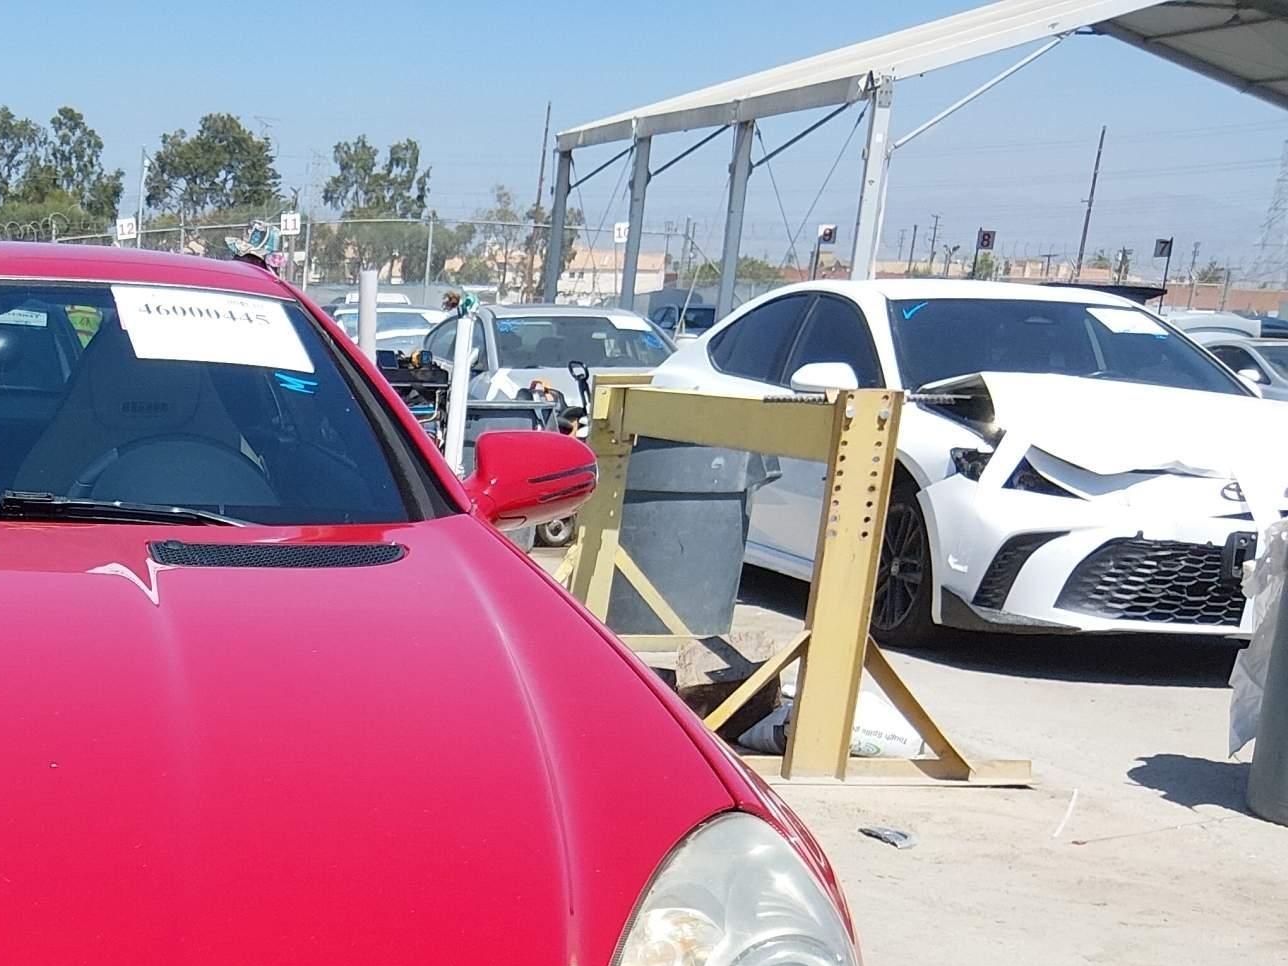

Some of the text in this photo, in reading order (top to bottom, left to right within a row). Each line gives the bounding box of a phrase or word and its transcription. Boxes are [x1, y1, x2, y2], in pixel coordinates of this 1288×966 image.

[119, 222, 135, 235] 12
[282, 218, 299, 231] 11
[824, 228, 833, 241] 9
[981, 234, 991, 246] 8
[1159, 240, 1170, 255] 7
[137, 302, 271, 326] 46000445
